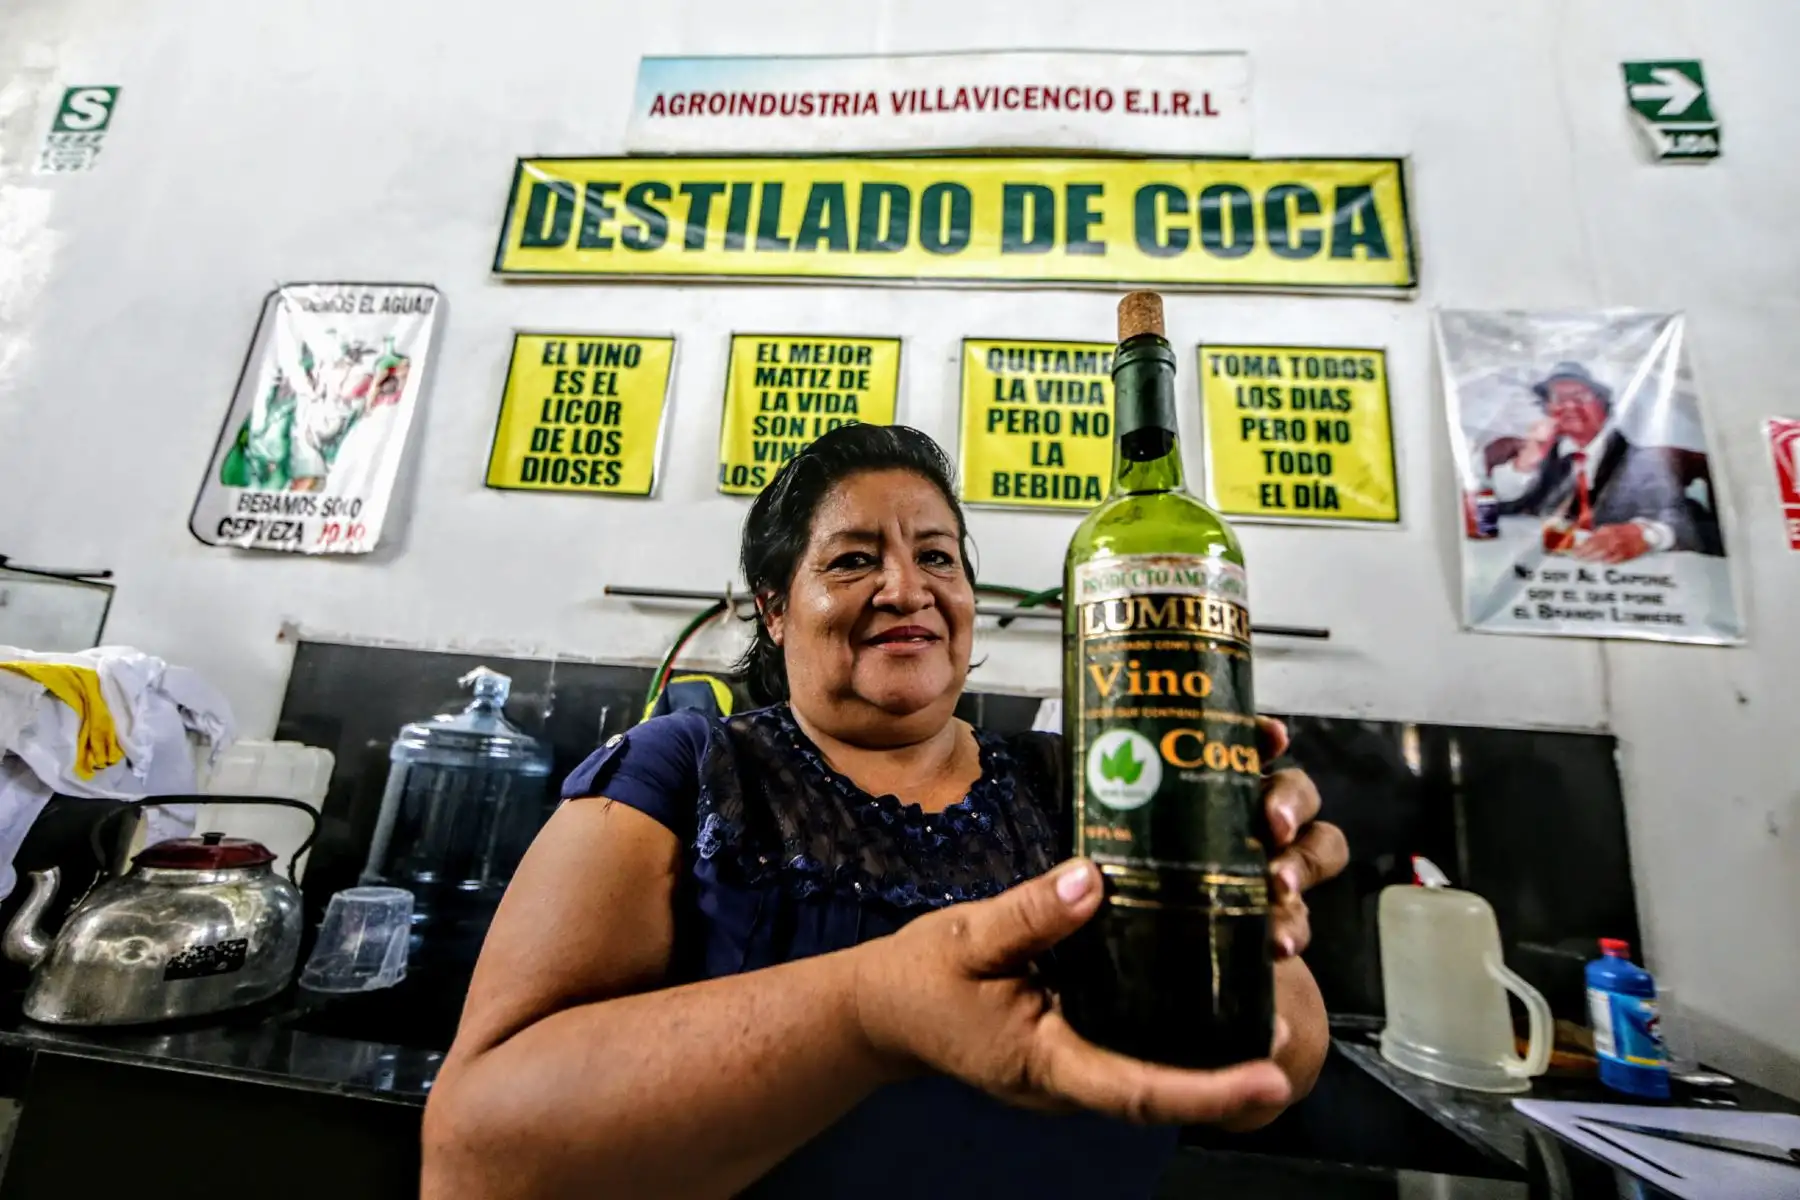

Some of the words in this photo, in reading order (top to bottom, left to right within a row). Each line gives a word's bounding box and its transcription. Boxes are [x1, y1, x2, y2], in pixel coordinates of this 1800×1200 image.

[62, 88, 112, 130] S
[650, 91, 879, 117] AGROINDUSTRIA
[890, 85, 1113, 115] VILLAVICENCIO
[1124, 88, 1219, 117] E.I.R.L
[520, 179, 973, 256] DESTILADO
[1000, 182, 1105, 257] DE
[1134, 182, 1393, 262] COCA
[541, 341, 568, 365] EL
[576, 342, 642, 368] VINO
[756, 342, 781, 363] EL
[789, 344, 872, 366] MEJOR
[1209, 353, 1283, 378] TOMA
[1288, 355, 1376, 381] TODOS
[553, 370, 585, 395] ES
[592, 371, 619, 396] EL
[754, 367, 832, 389] MATIZ
[838, 369, 870, 390] DE
[994, 378, 1026, 403] LA
[1034, 379, 1105, 405] VIDA
[540, 398, 622, 426] LICOR
[759, 391, 788, 412] LA
[797, 392, 859, 414] VIDA
[1235, 386, 1282, 410] LOS
[1290, 387, 1352, 413] DIAS
[752, 415, 806, 438] SON
[986, 408, 1060, 435] PERO
[1070, 411, 1110, 437] NO
[1240, 417, 1306, 442] PERO
[1315, 419, 1350, 444] NO
[530, 427, 566, 454] DE
[571, 428, 623, 456] LOS
[752, 440, 810, 463] VIN
[1030, 441, 1065, 468] LA
[520, 456, 623, 486] DIOSES
[719, 463, 766, 488] LOS
[1261, 449, 1332, 477] TODO
[991, 471, 1103, 501] BEBIDA
[1259, 482, 1286, 509] EL
[1293, 480, 1341, 510] DÍA
[237, 491, 318, 517] BEBAMOS
[216, 516, 304, 544] CERVEZA
[1088, 659, 1213, 698] Vino
[1159, 727, 1261, 775] Coca
